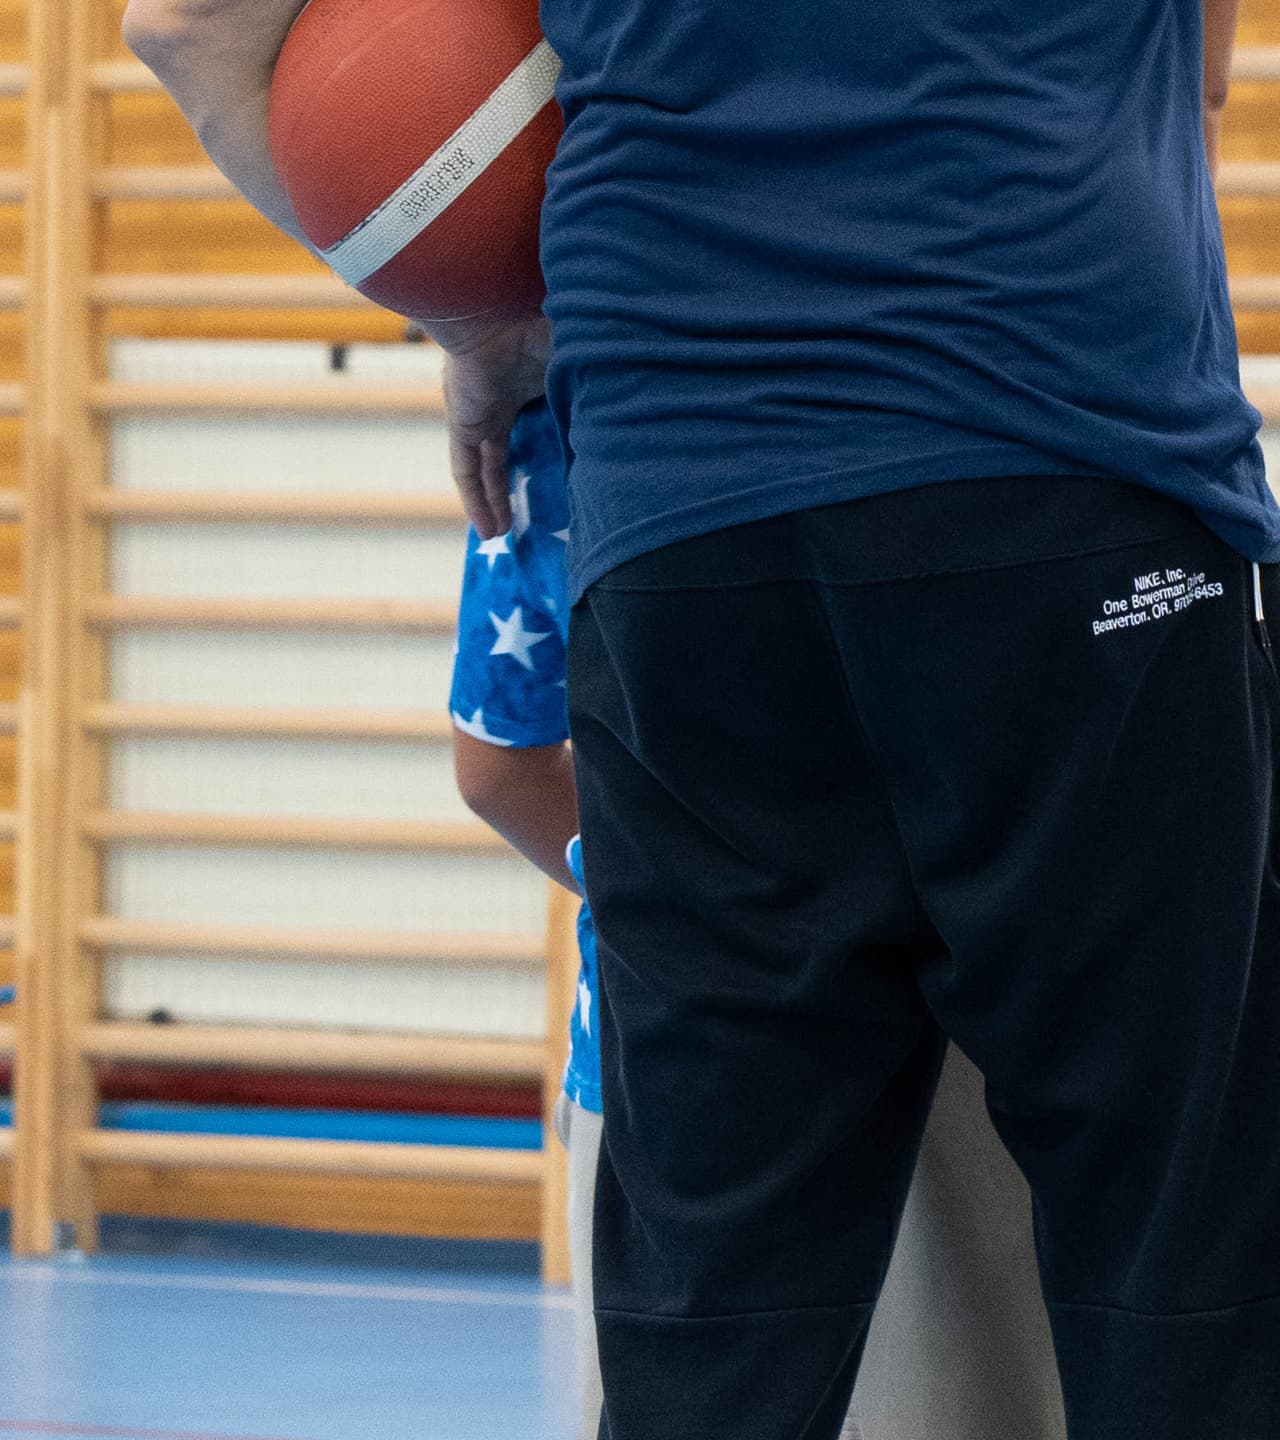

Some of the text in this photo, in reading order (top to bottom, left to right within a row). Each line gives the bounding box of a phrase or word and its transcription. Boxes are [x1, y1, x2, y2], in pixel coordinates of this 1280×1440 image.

[1165, 568, 1186, 583] Inc.
[1103, 599, 1128, 615] One
[1131, 583, 1186, 609] Bowerman
